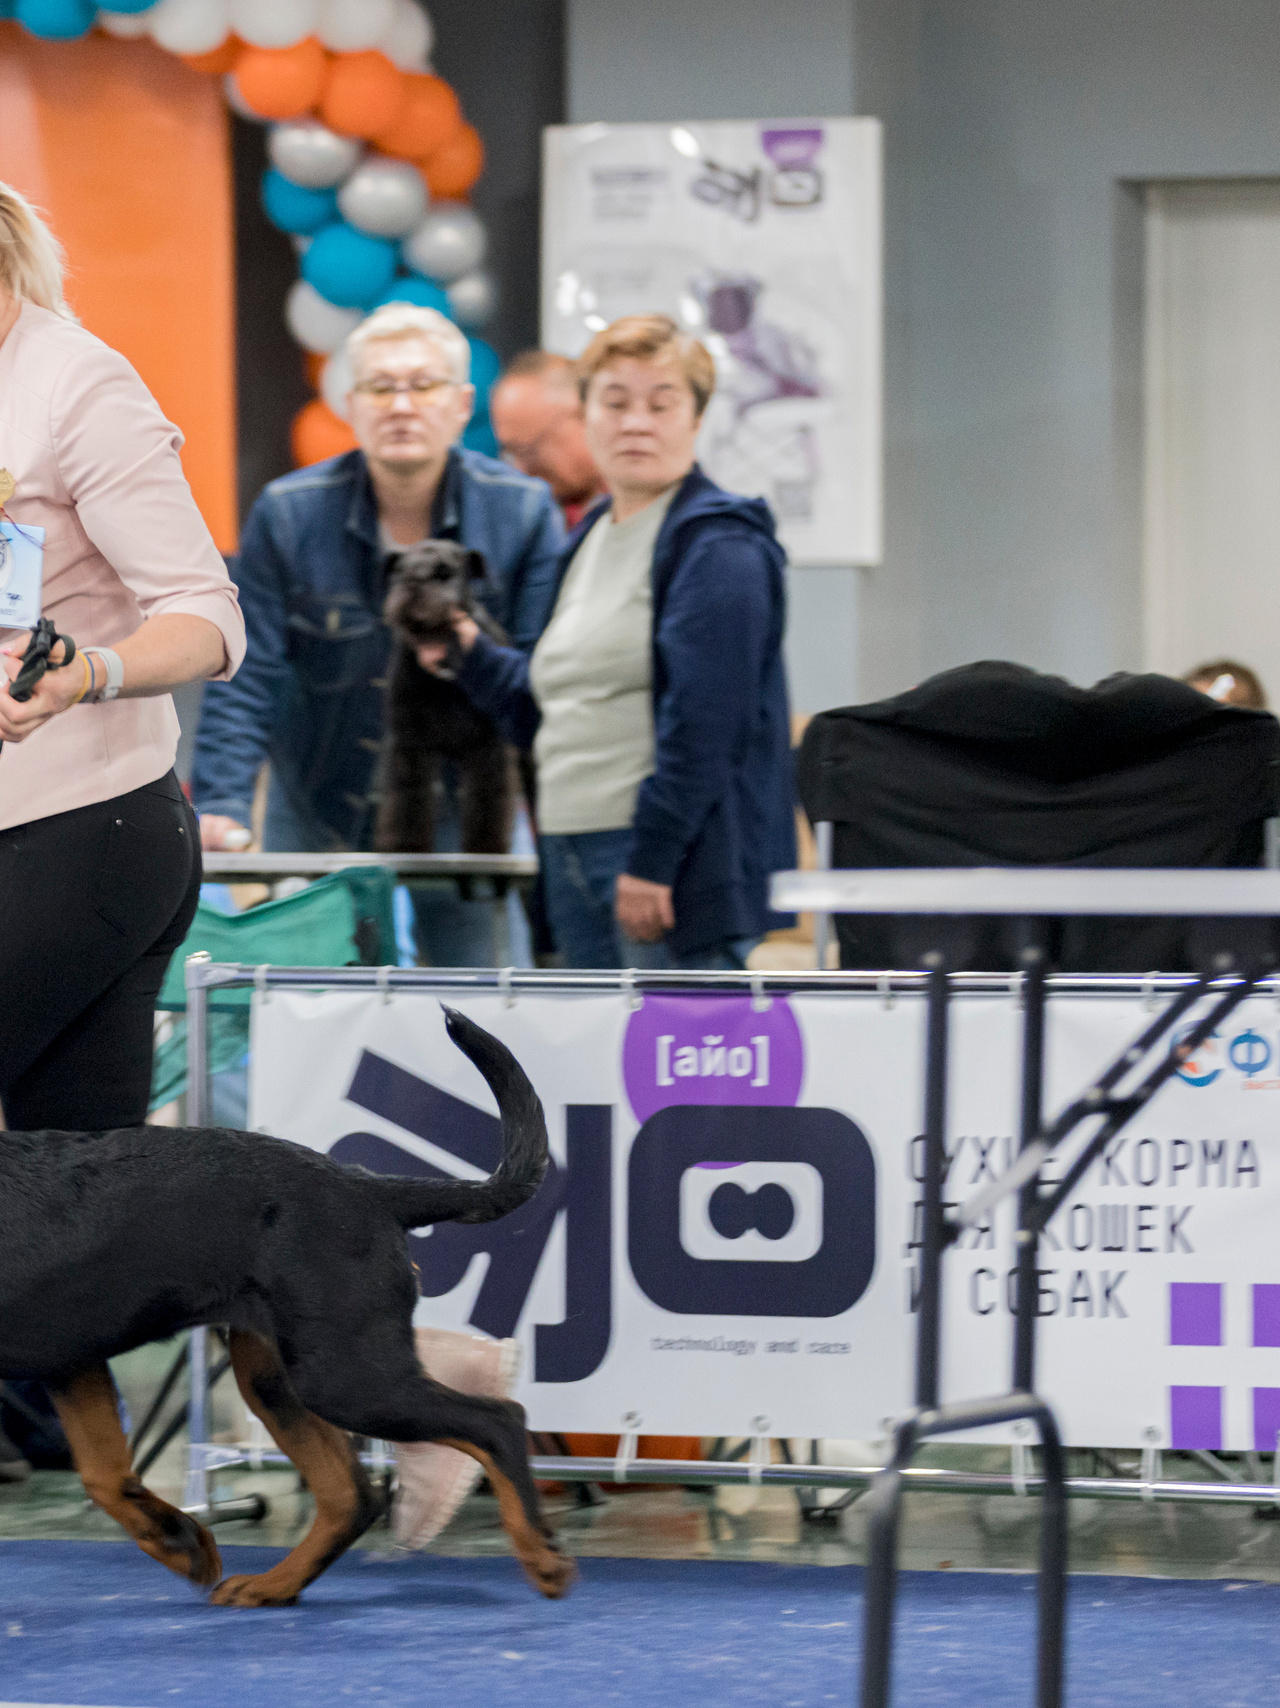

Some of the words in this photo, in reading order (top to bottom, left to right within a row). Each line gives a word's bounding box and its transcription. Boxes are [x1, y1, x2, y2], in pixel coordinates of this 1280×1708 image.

[1168, 1018, 1280, 1088] СФ
[1099, 1138, 1261, 1188] КОРМА
[765, 1339, 799, 1353] and
